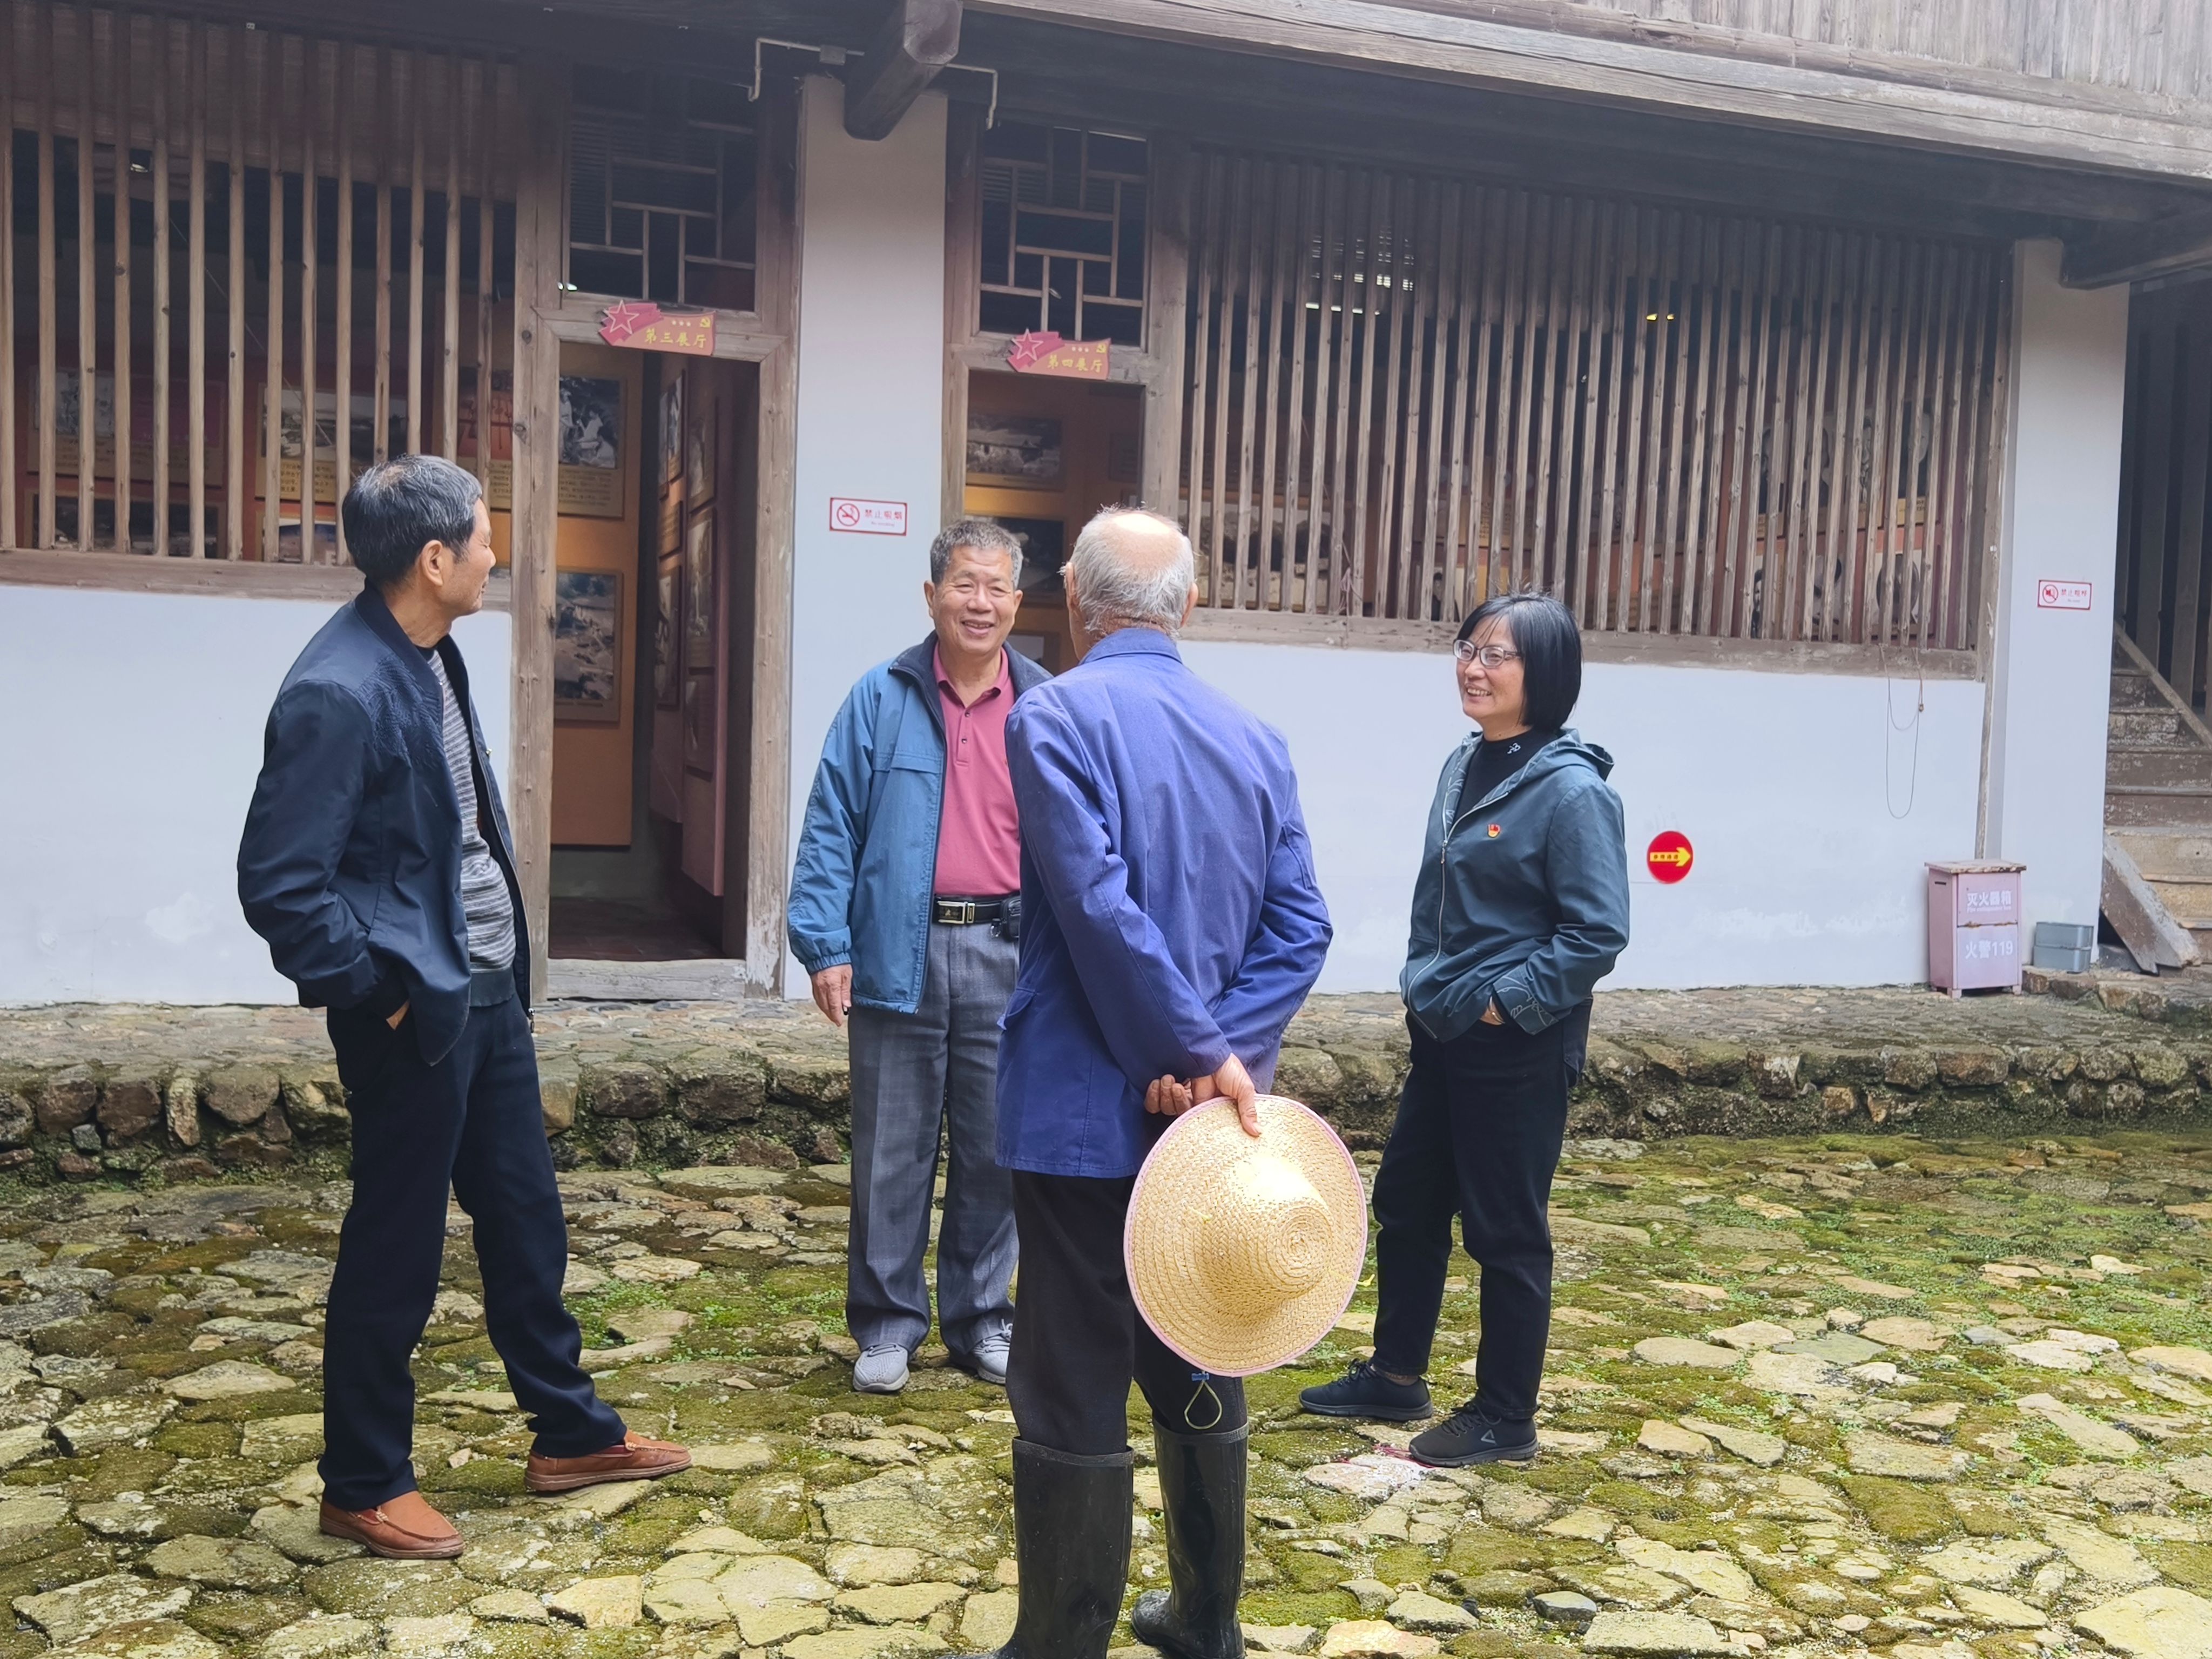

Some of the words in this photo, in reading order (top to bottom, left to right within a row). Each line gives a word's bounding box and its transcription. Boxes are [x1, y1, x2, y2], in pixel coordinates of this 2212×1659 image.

[644, 327, 707, 348] 第三展厅
[1047, 354, 1103, 373] 第四展厅
[1965, 940, 2013, 959] 火警119
